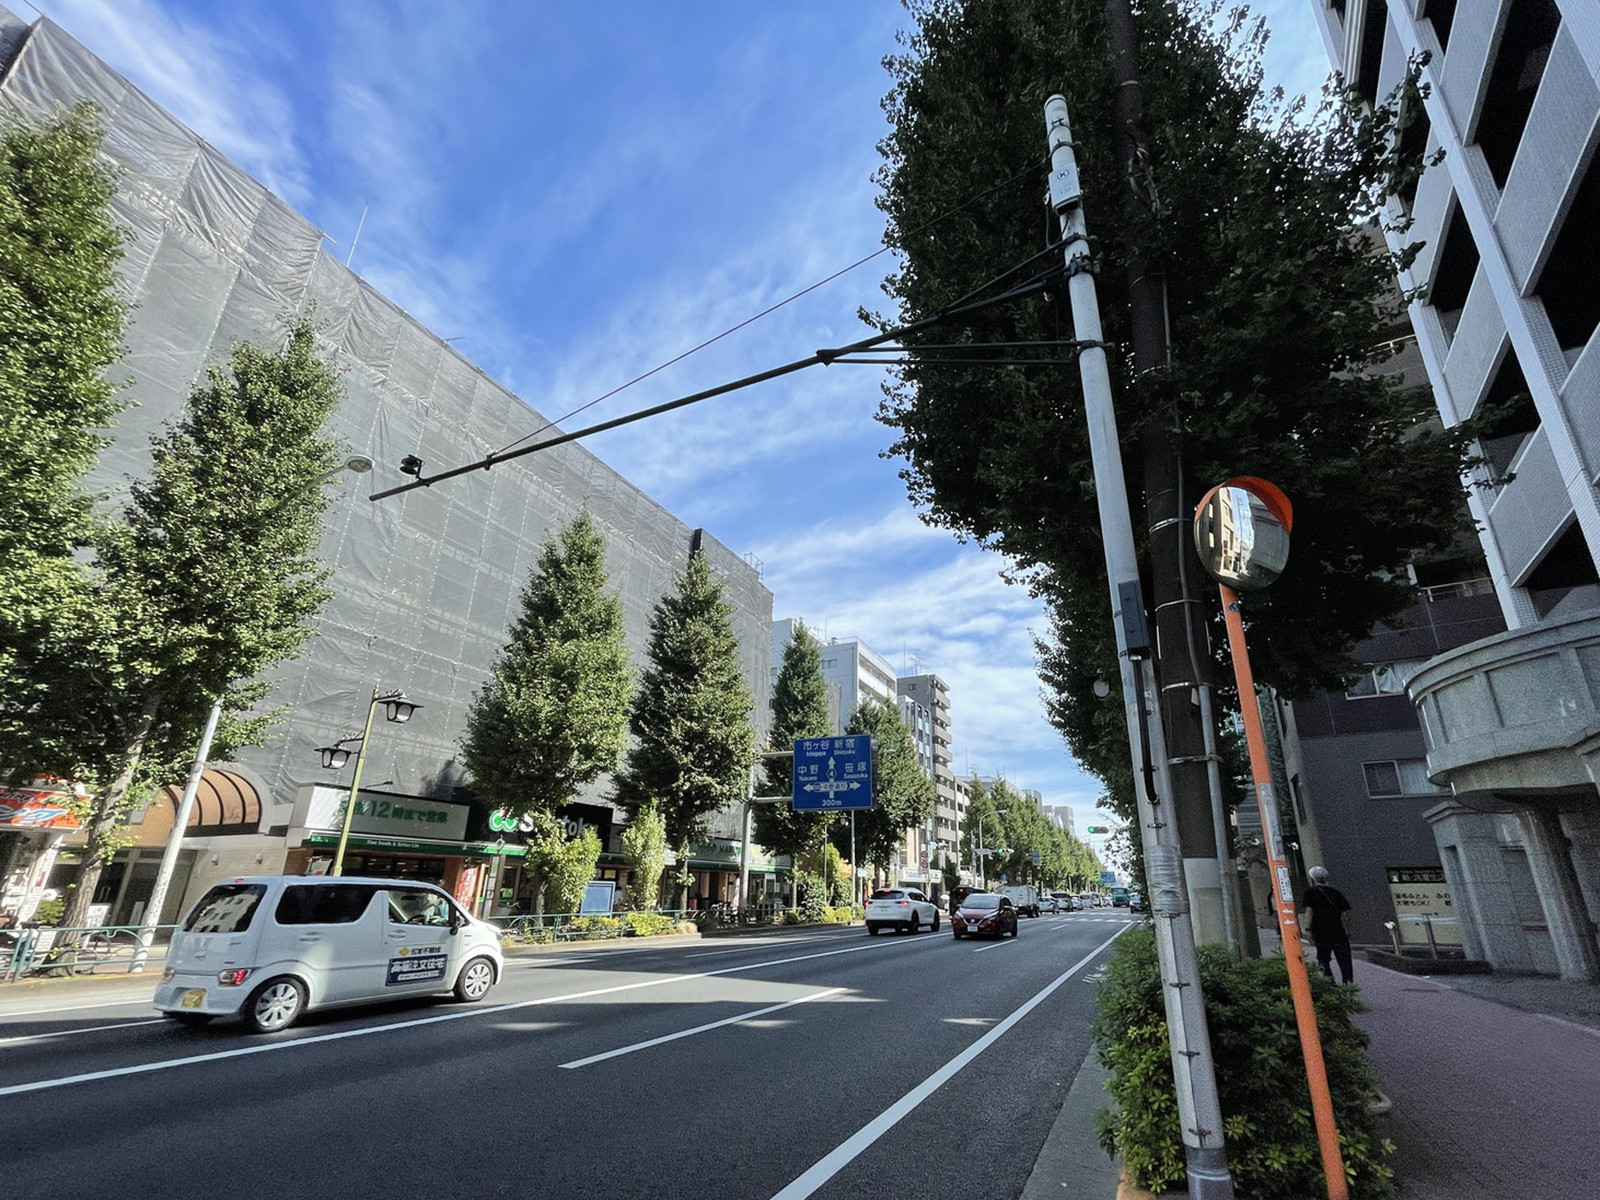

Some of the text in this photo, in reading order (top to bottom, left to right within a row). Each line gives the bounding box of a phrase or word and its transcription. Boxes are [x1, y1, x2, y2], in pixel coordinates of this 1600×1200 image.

[803, 739, 855, 750] 市ヶ谷 新宿
[797, 764, 818, 775] 中野
[845, 762, 867, 772] 笹塚
